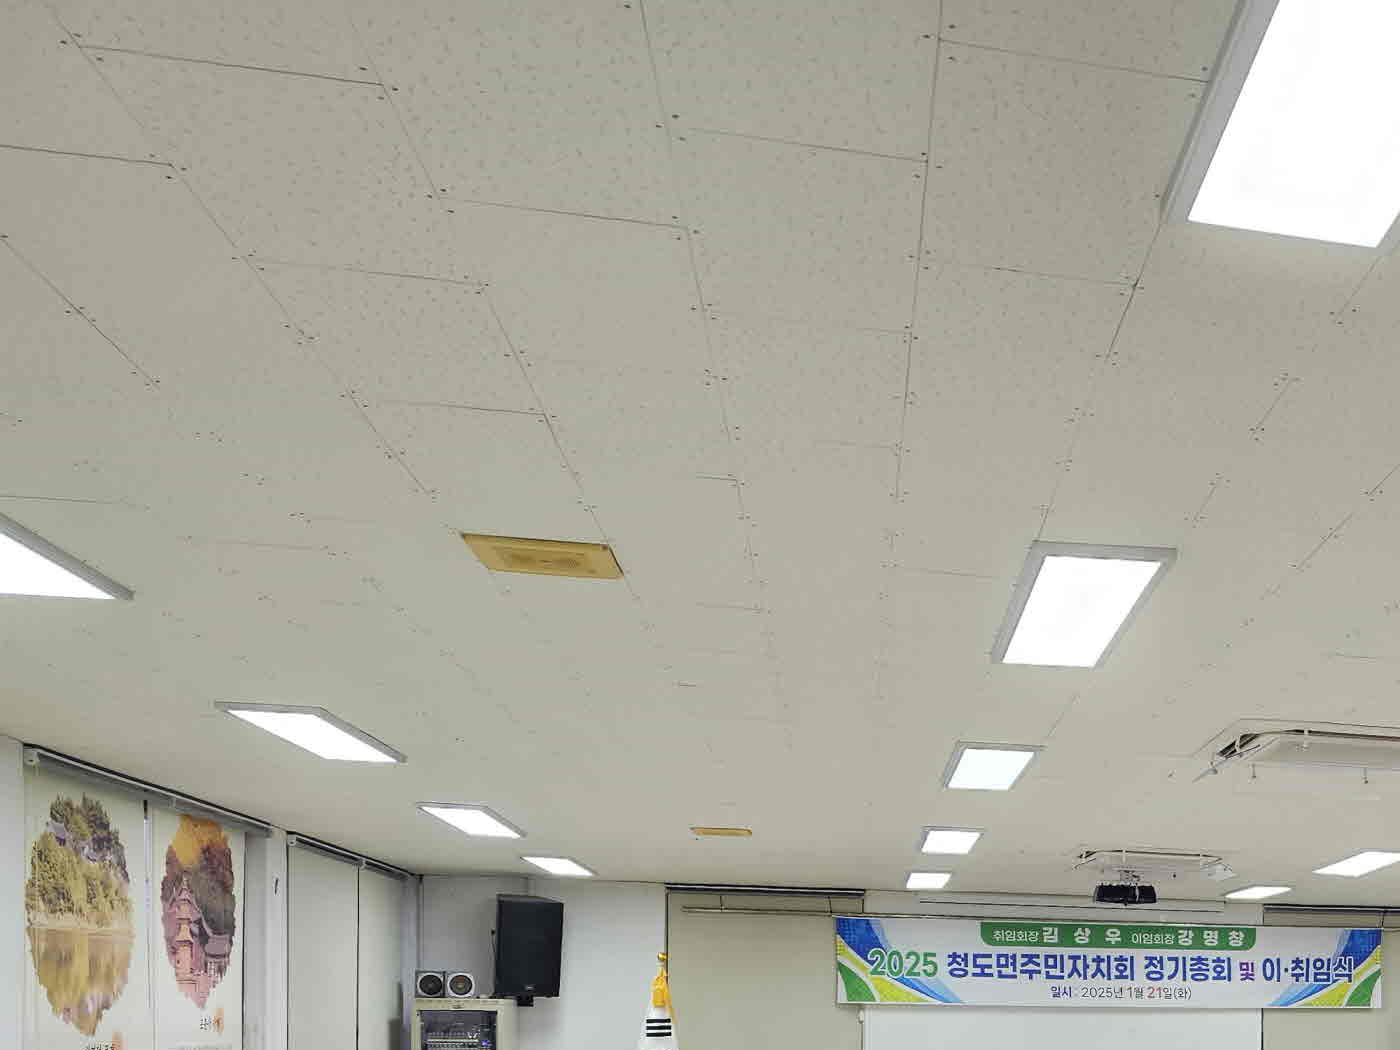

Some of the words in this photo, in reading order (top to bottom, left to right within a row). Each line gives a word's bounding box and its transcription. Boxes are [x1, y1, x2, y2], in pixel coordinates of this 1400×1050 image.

[992, 930, 1039, 943] 취임회장
[1131, 932, 1175, 945] 이임회장
[867, 948, 939, 978] 2025
[947, 951, 1135, 981] 청도면주민자치회
[1143, 955, 1232, 982] 정기총회
[1239, 961, 1255, 982] 및
[1050, 986, 1072, 998] 일시
[1081, 986, 1124, 999] 2025년
[1127, 986, 1144, 999] 1월
[1147, 986, 1192, 1000] 21일(화)
